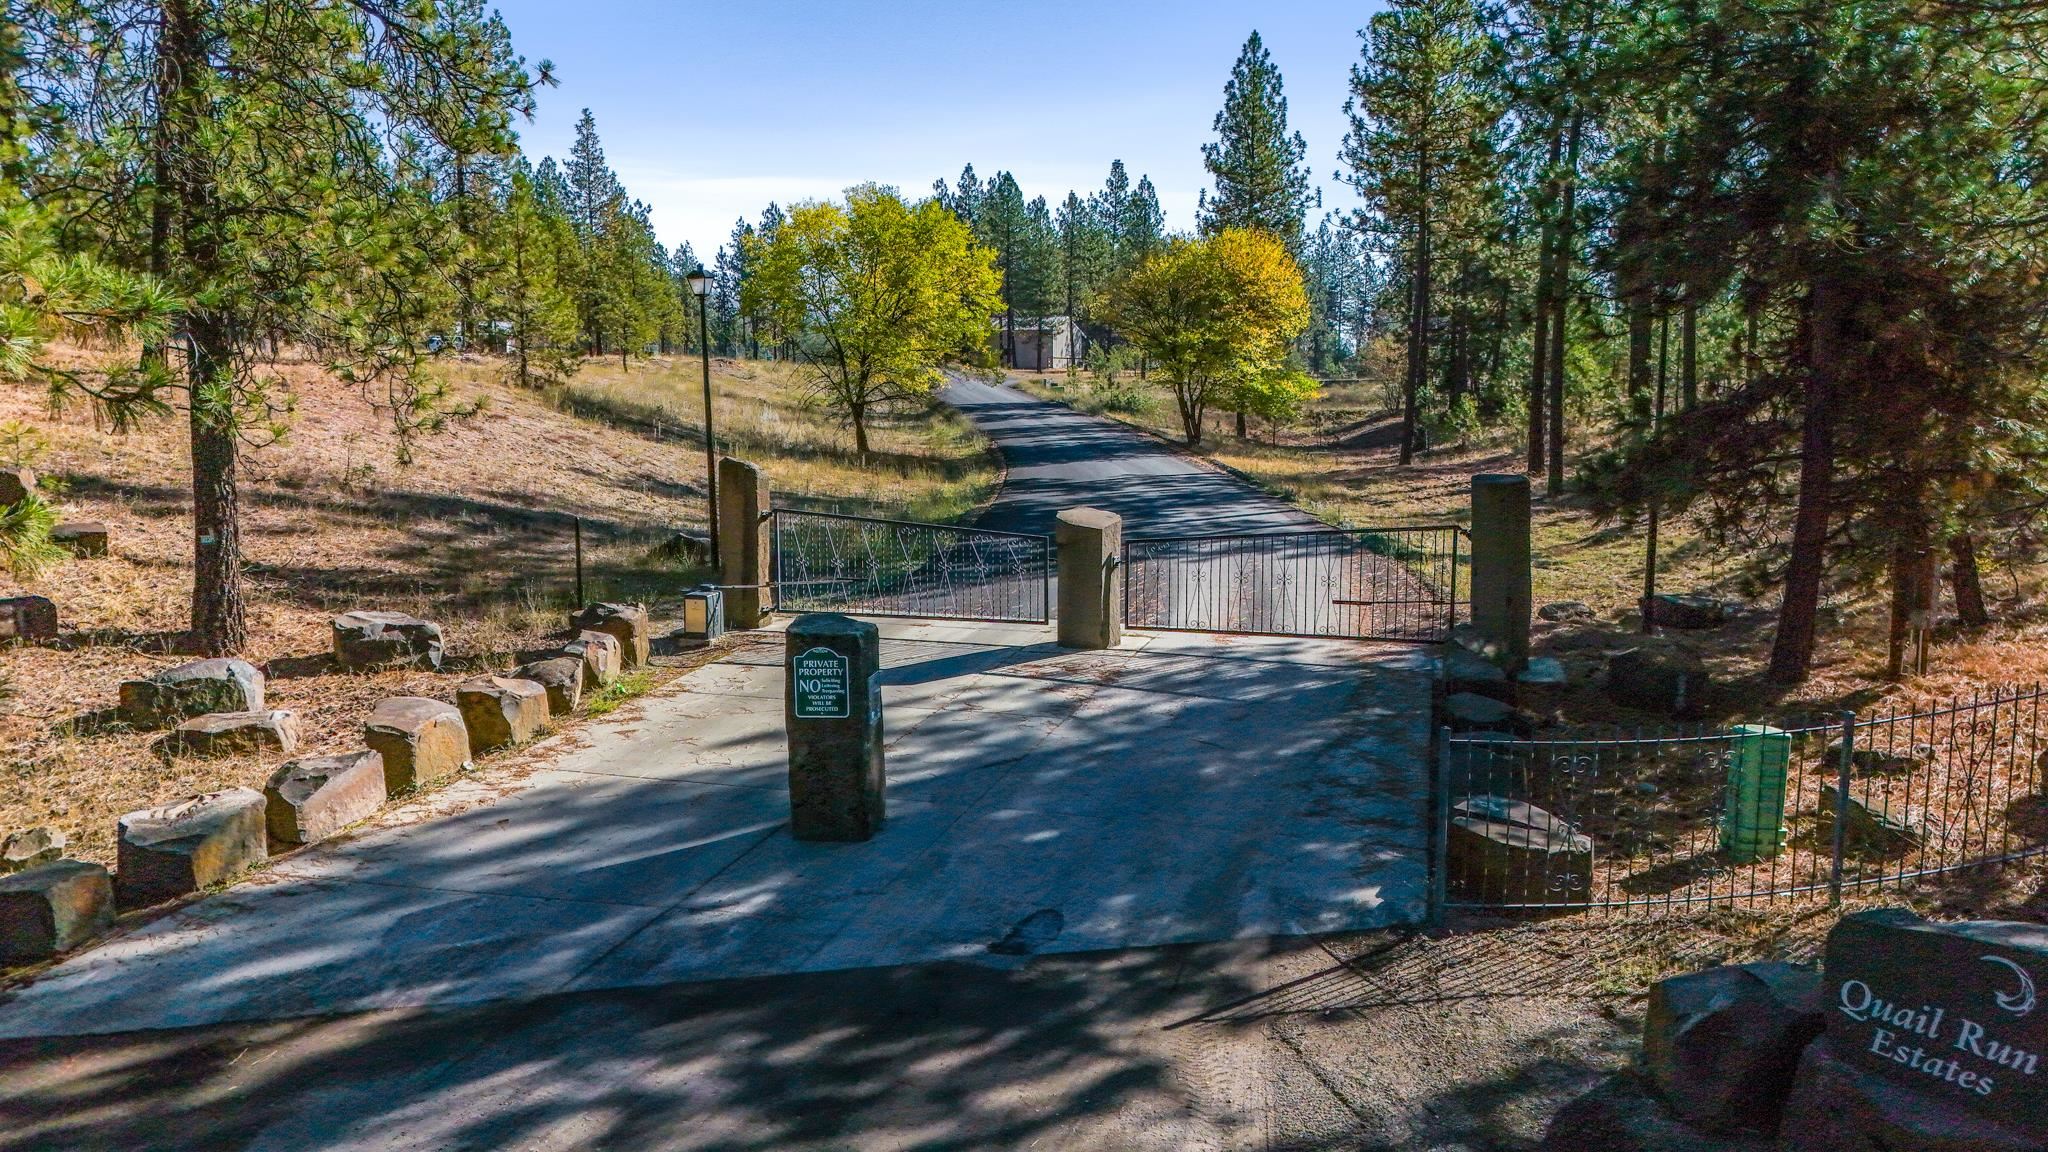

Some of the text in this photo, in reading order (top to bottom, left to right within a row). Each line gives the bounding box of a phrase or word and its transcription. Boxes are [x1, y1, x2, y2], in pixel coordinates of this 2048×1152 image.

[803, 660, 839, 668] PRIVATE
[798, 668, 843, 676] PROPERTY
[799, 679, 821, 693] NO
[1838, 980, 2039, 1075] Quail Run
[1869, 1027, 1995, 1096] Estates
